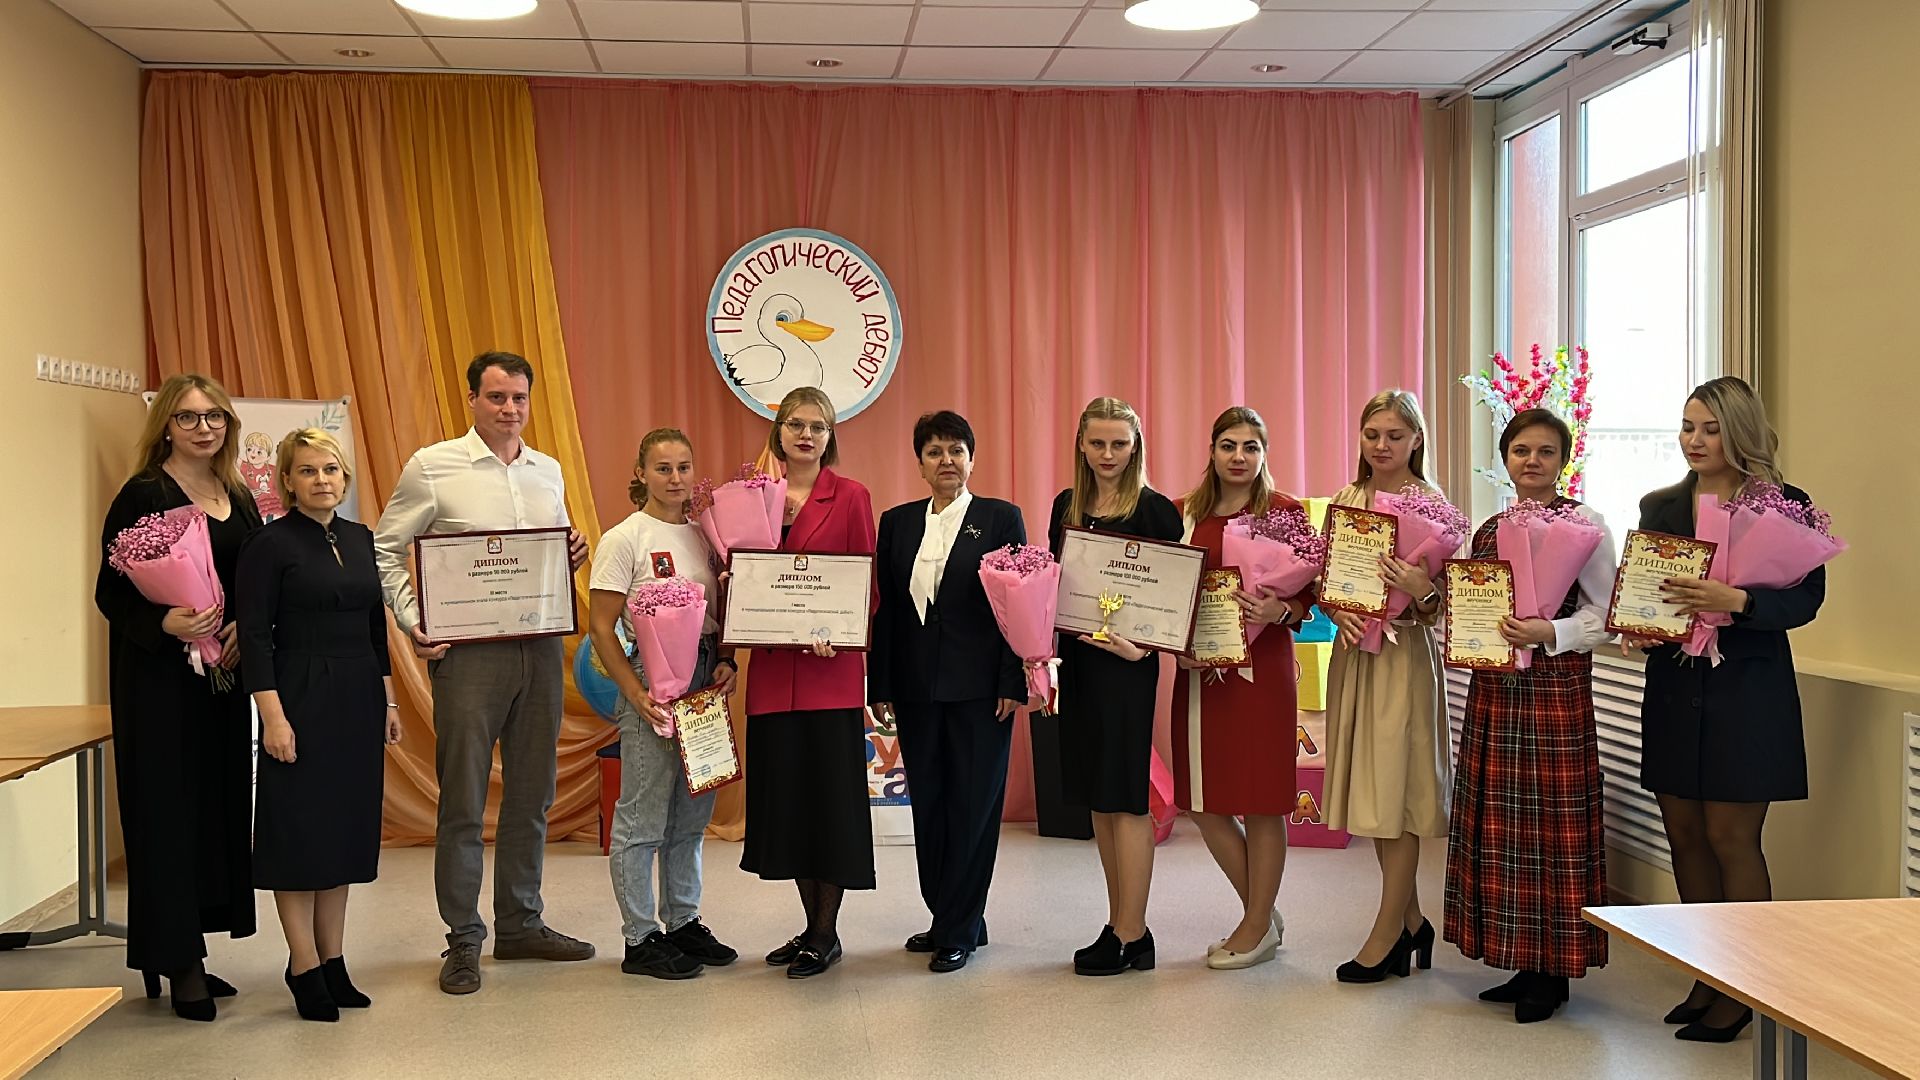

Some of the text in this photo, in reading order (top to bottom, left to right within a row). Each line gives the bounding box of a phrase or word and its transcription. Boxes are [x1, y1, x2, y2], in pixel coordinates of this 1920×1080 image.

[711, 242, 879, 334] Педагогический
[1338, 533, 1385, 549] ДИПЛОМ
[473, 557, 519, 568] ДИПЛОМ
[1107, 559, 1151, 574] ДИПЛОМ
[1633, 556, 1695, 575] ДИПЛОМ
[777, 574, 822, 582] ДИПЛОМ
[1201, 594, 1234, 603] ИПЛОМ
[1456, 587, 1504, 598] ДИПЛОМ
[685, 712, 722, 731] ДИПЛОМ
[1291, 791, 1322, 824] А
